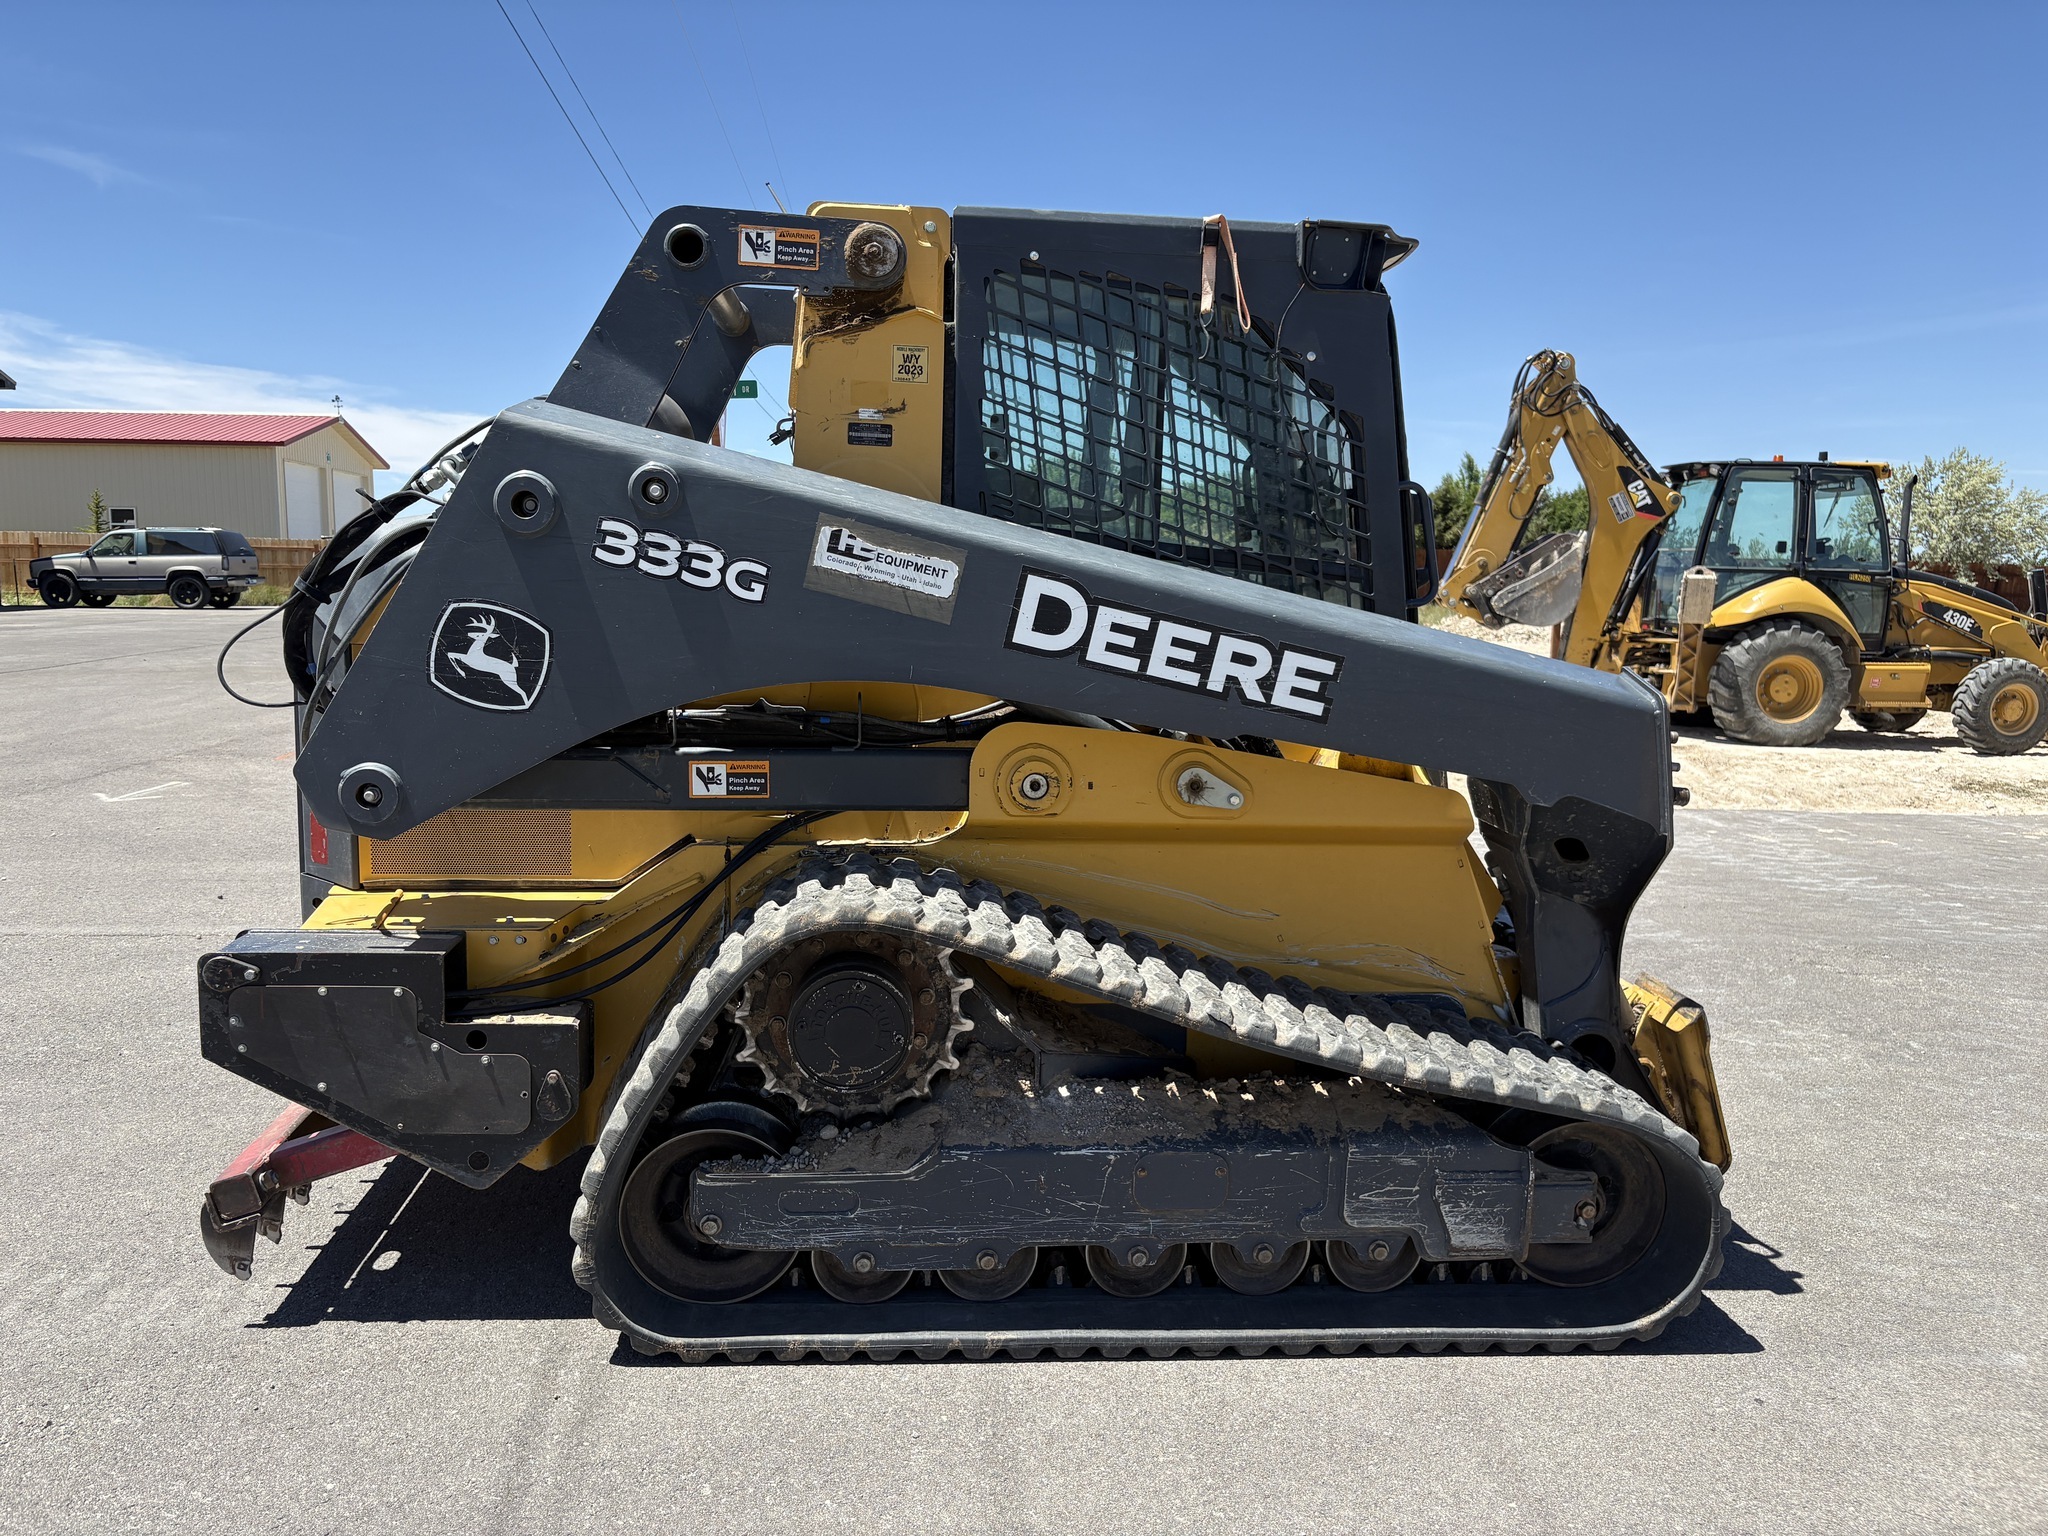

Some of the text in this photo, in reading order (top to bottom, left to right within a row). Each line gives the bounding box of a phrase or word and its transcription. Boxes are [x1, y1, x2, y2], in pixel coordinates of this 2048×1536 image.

[785, 232, 816, 240] WARNING
[777, 245, 797, 253] Pinch
[793, 255, 809, 263] Away
[897, 364, 923, 376] 2023
[902, 353, 921, 364] WY
[1627, 479, 1653, 509] CAT
[597, 517, 769, 603] 333G
[826, 554, 942, 590] Colorado Wyoming Utah Idaho
[876, 552, 949, 580] EQUIPMENT
[1942, 608, 1975, 633] 430E
[1011, 573, 1337, 717] DEERE
